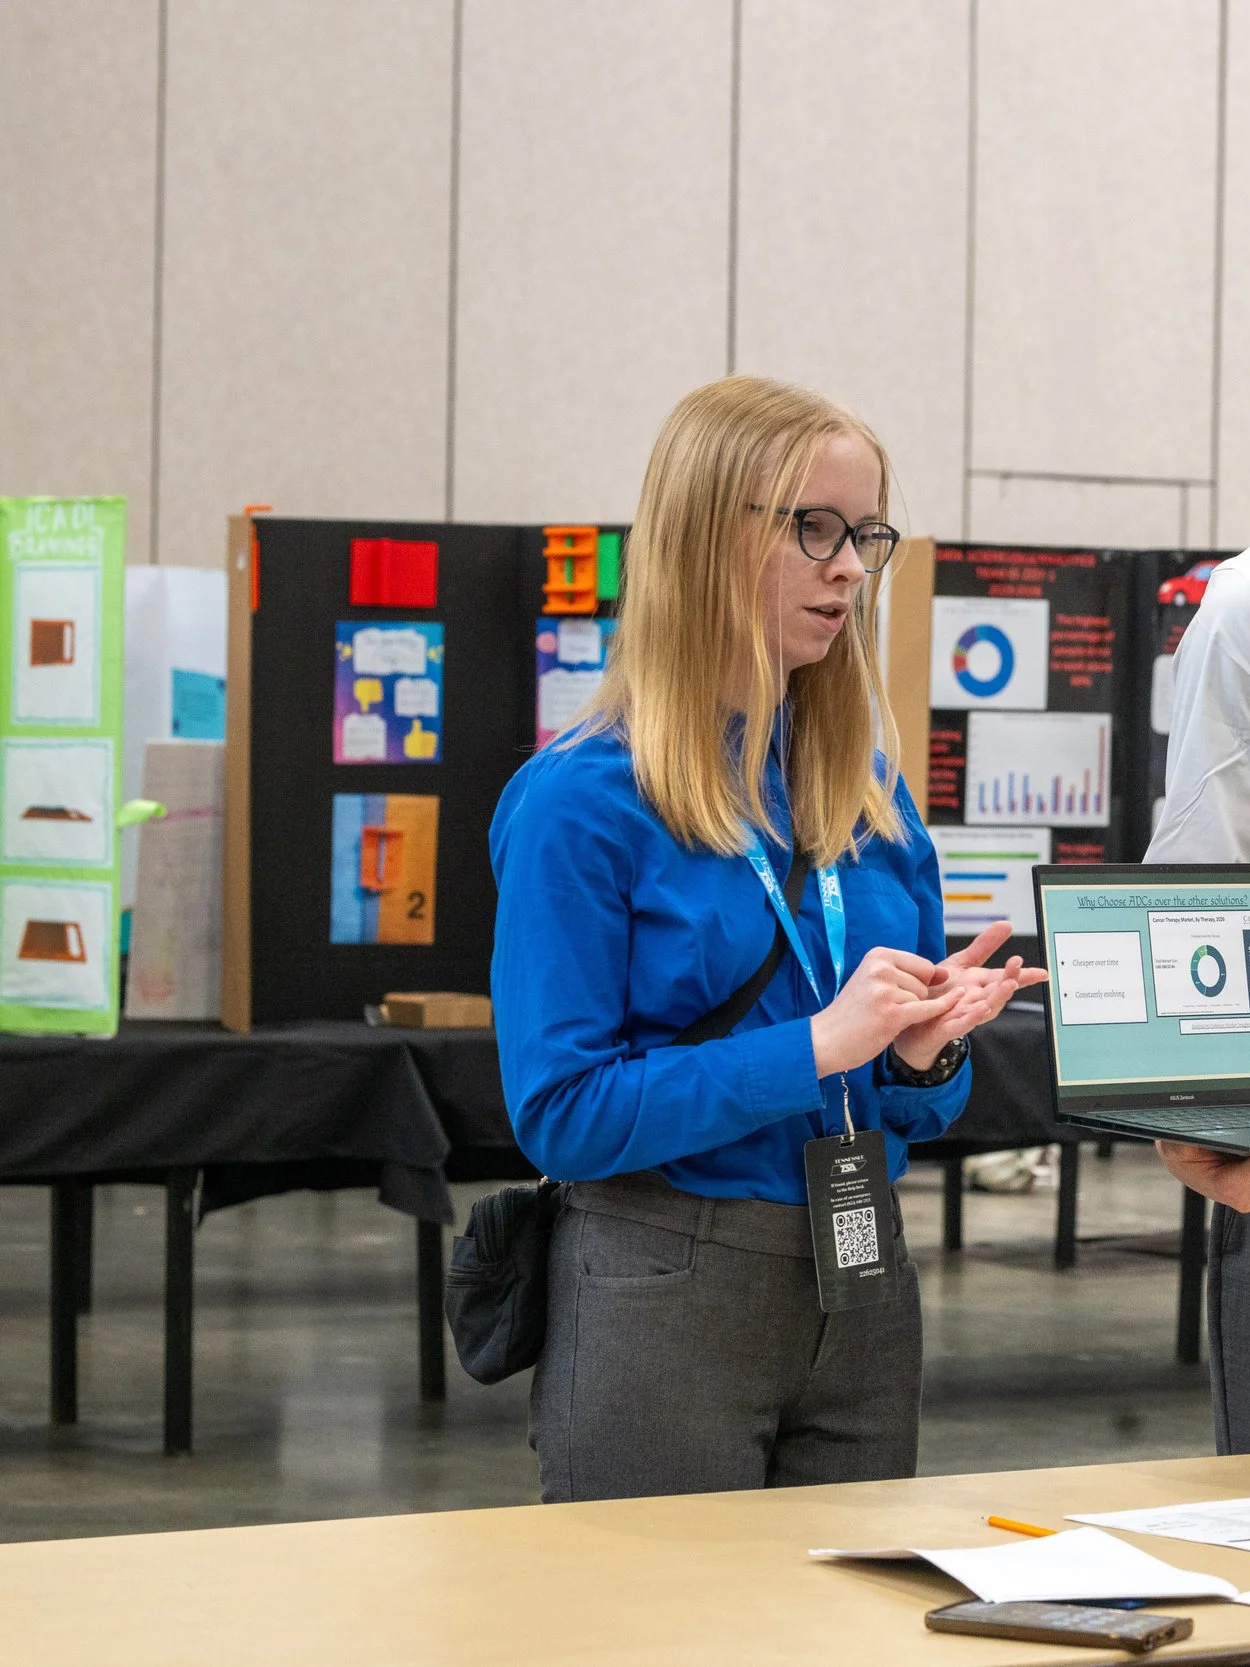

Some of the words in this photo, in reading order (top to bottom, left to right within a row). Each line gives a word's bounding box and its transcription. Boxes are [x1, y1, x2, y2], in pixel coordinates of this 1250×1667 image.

[407, 890, 427, 920] 2
[1077, 896, 1096, 910] Why
[1098, 895, 1127, 907] Choose
[1128, 896, 1152, 907] ADCs
[1155, 898, 1171, 906] over
[1173, 895, 1186, 906] the
[1188, 895, 1208, 906] other
[1210, 894, 1248, 906] solutions?
[1201, 916, 1216, 924] Therapy,
[1072, 958, 1094, 968] Cheaper
[1107, 958, 1119, 966] time
[1075, 990, 1102, 1000] Constantly
[1104, 989, 1125, 1000] evolving
[840, 1163, 858, 1173] TSA
